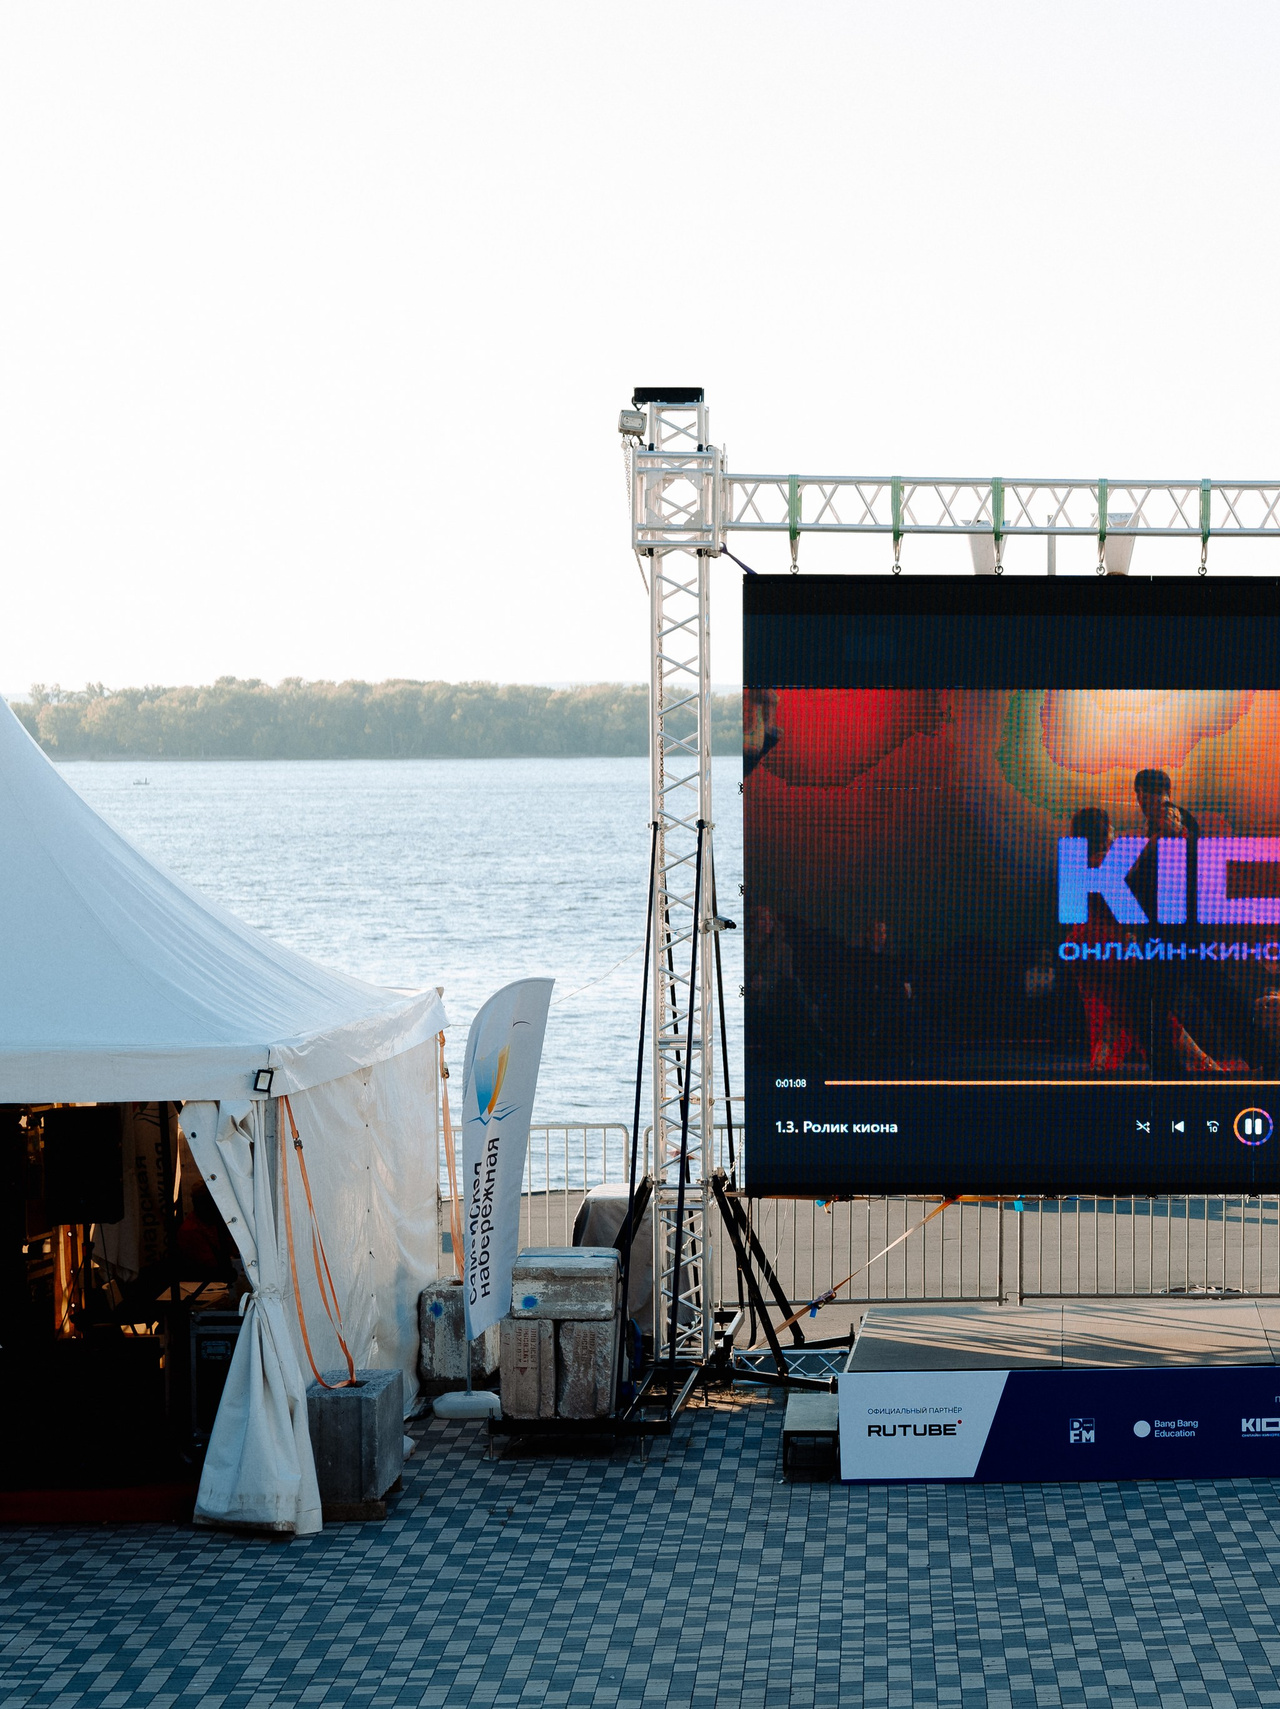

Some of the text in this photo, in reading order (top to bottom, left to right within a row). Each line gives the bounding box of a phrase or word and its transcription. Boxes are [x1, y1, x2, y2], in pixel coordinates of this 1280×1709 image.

[775, 1078, 807, 1089] 0:01:08
[775, 1119, 898, 1135] 1.3. Ролик киона
[478, 1136, 500, 1299] набережная
[867, 1406, 928, 1415] ОФИЦИАЛЬНЫЙ
[1154, 1418, 1199, 1429] Bang Bang
[867, 1423, 957, 1437] RUTUBE
[1154, 1428, 1196, 1438] Education
